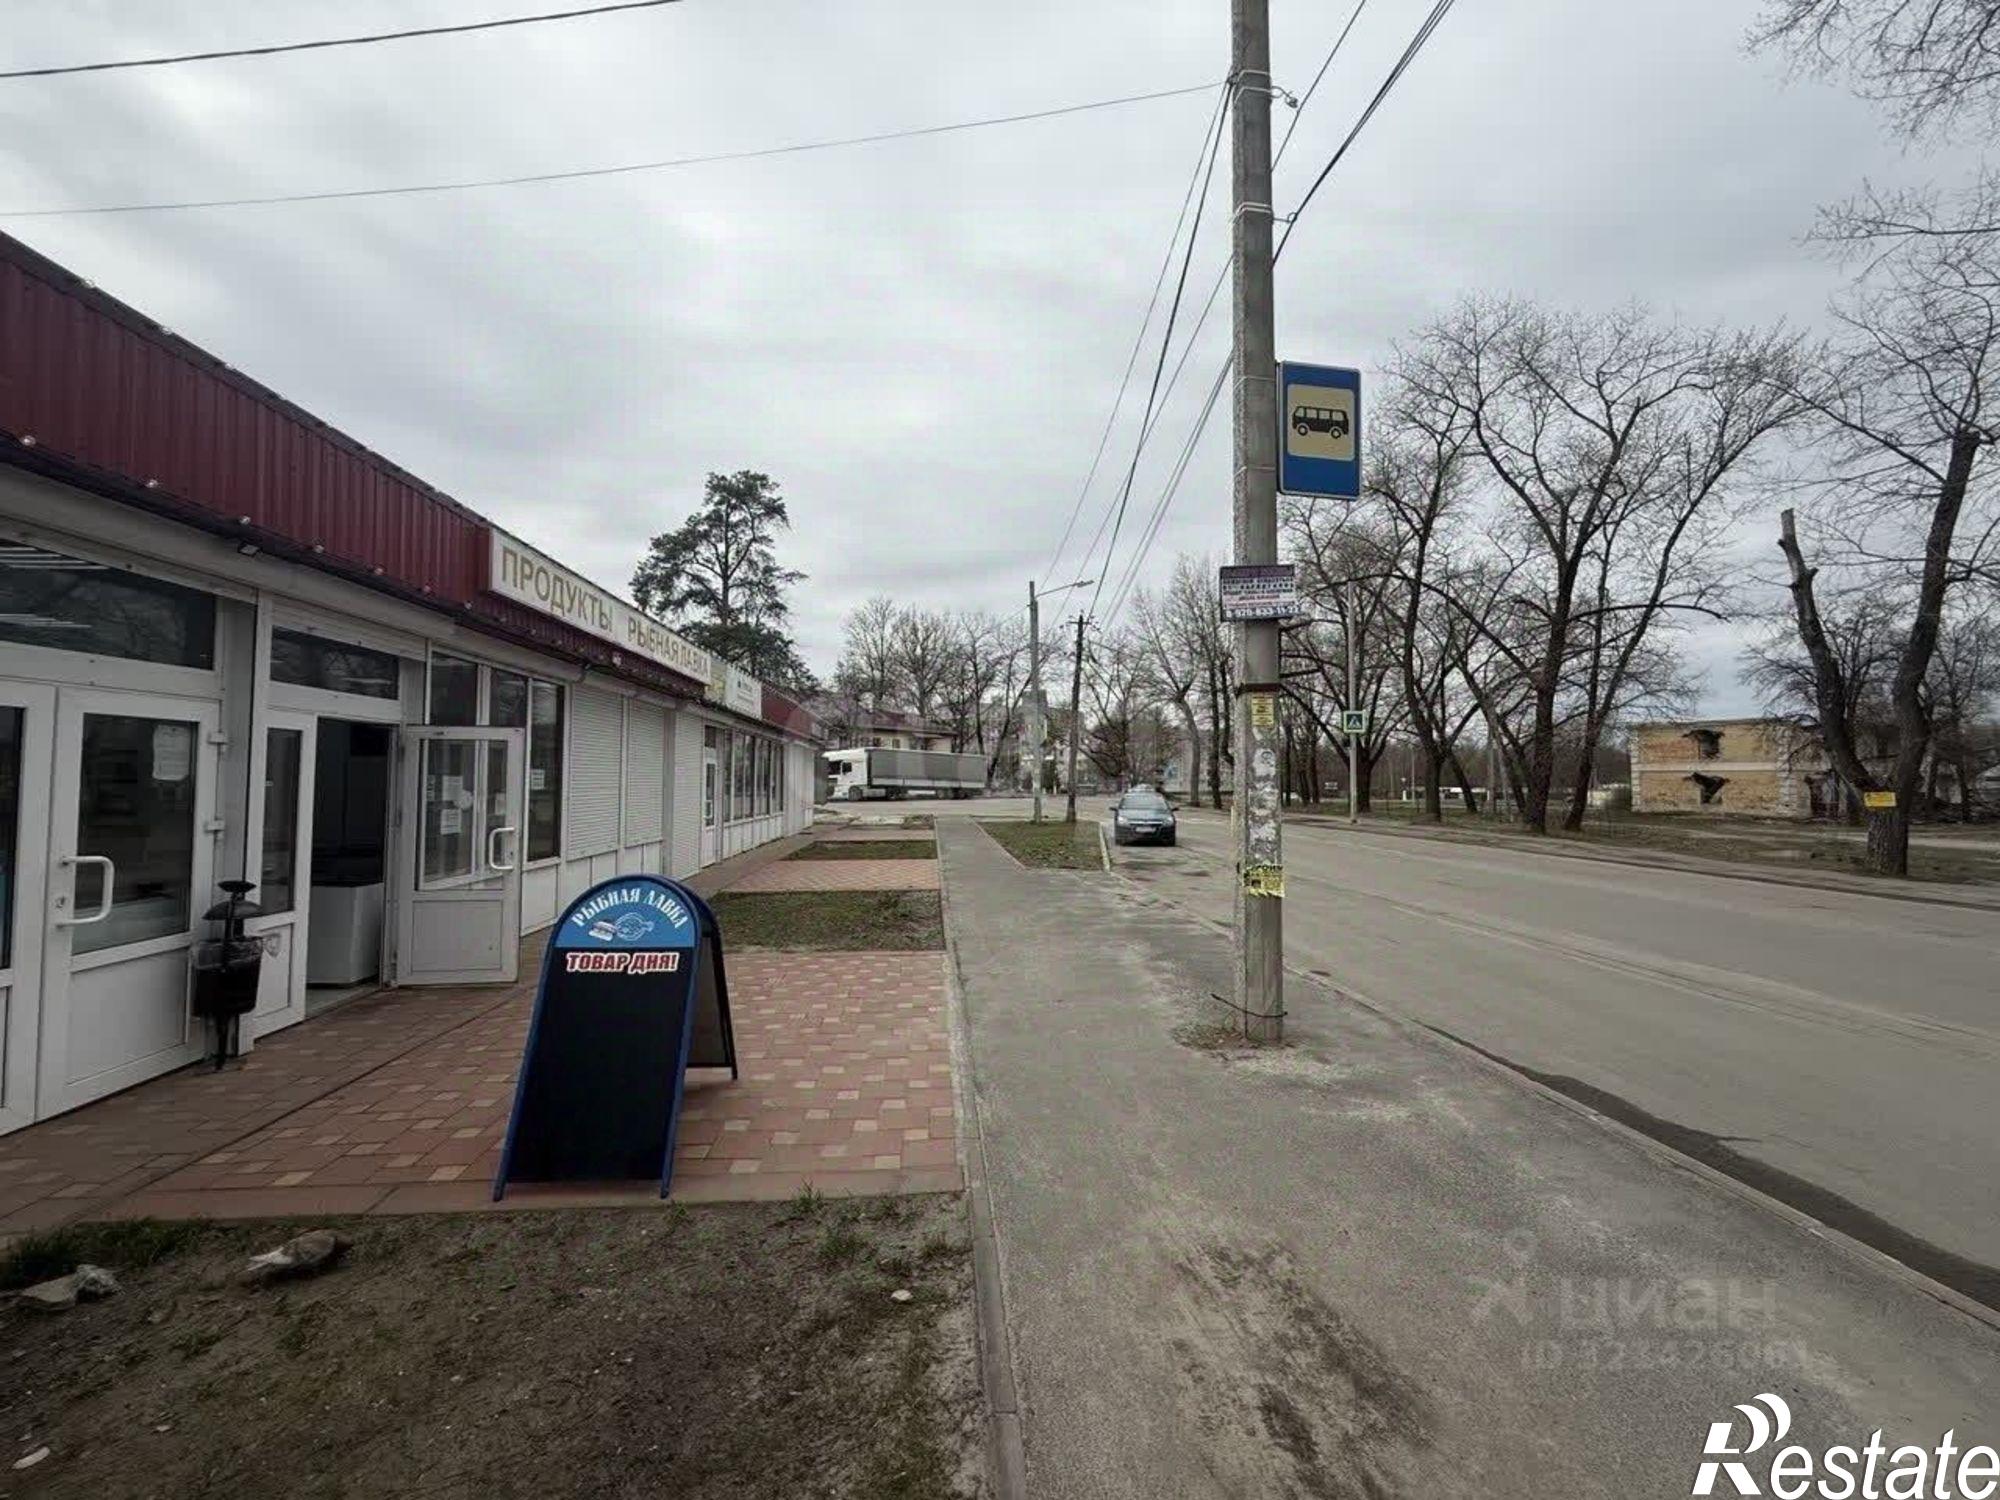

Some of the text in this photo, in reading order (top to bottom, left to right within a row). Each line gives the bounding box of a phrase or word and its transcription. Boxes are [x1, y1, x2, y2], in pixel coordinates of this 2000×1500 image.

[502, 546, 612, 632] ПРОДУКТЫ
[627, 616, 680, 664] РЫБНАЯ
[571, 887, 689, 929] РЫБНАЯ ЛАВКА
[566, 952, 680, 975] ТОВАР ДНЯ!
